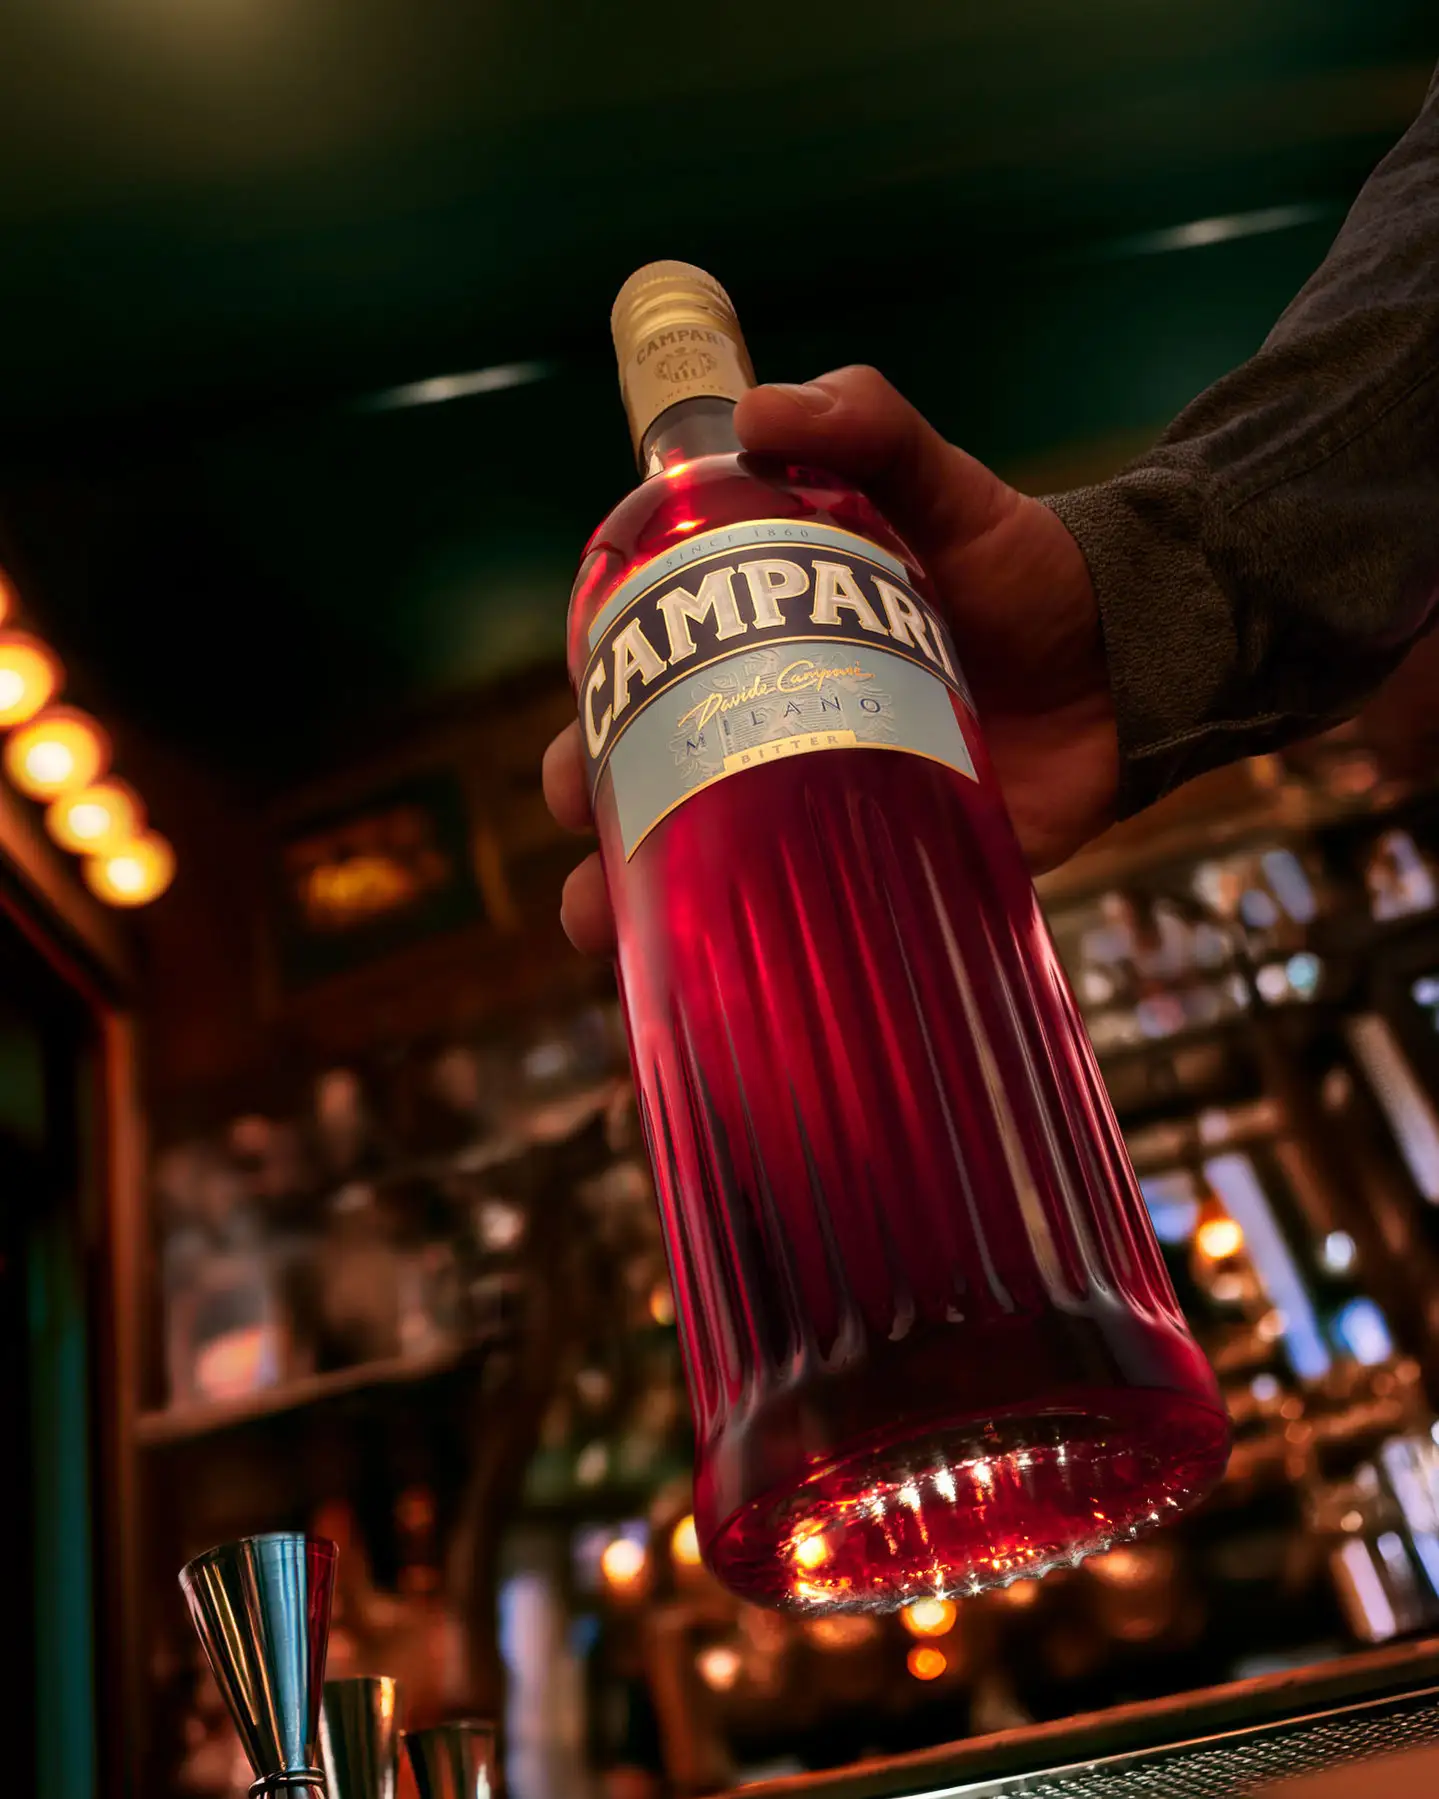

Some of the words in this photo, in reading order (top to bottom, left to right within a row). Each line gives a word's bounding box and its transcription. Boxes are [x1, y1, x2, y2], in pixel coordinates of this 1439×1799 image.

[754, 528, 809, 538] 1860
[584, 558, 959, 759] CAMPARI
[677, 675, 778, 732] Davide
[776, 660, 876, 693] Campari
[685, 695, 881, 757] MILANO
[740, 735, 839, 766] BITTER
